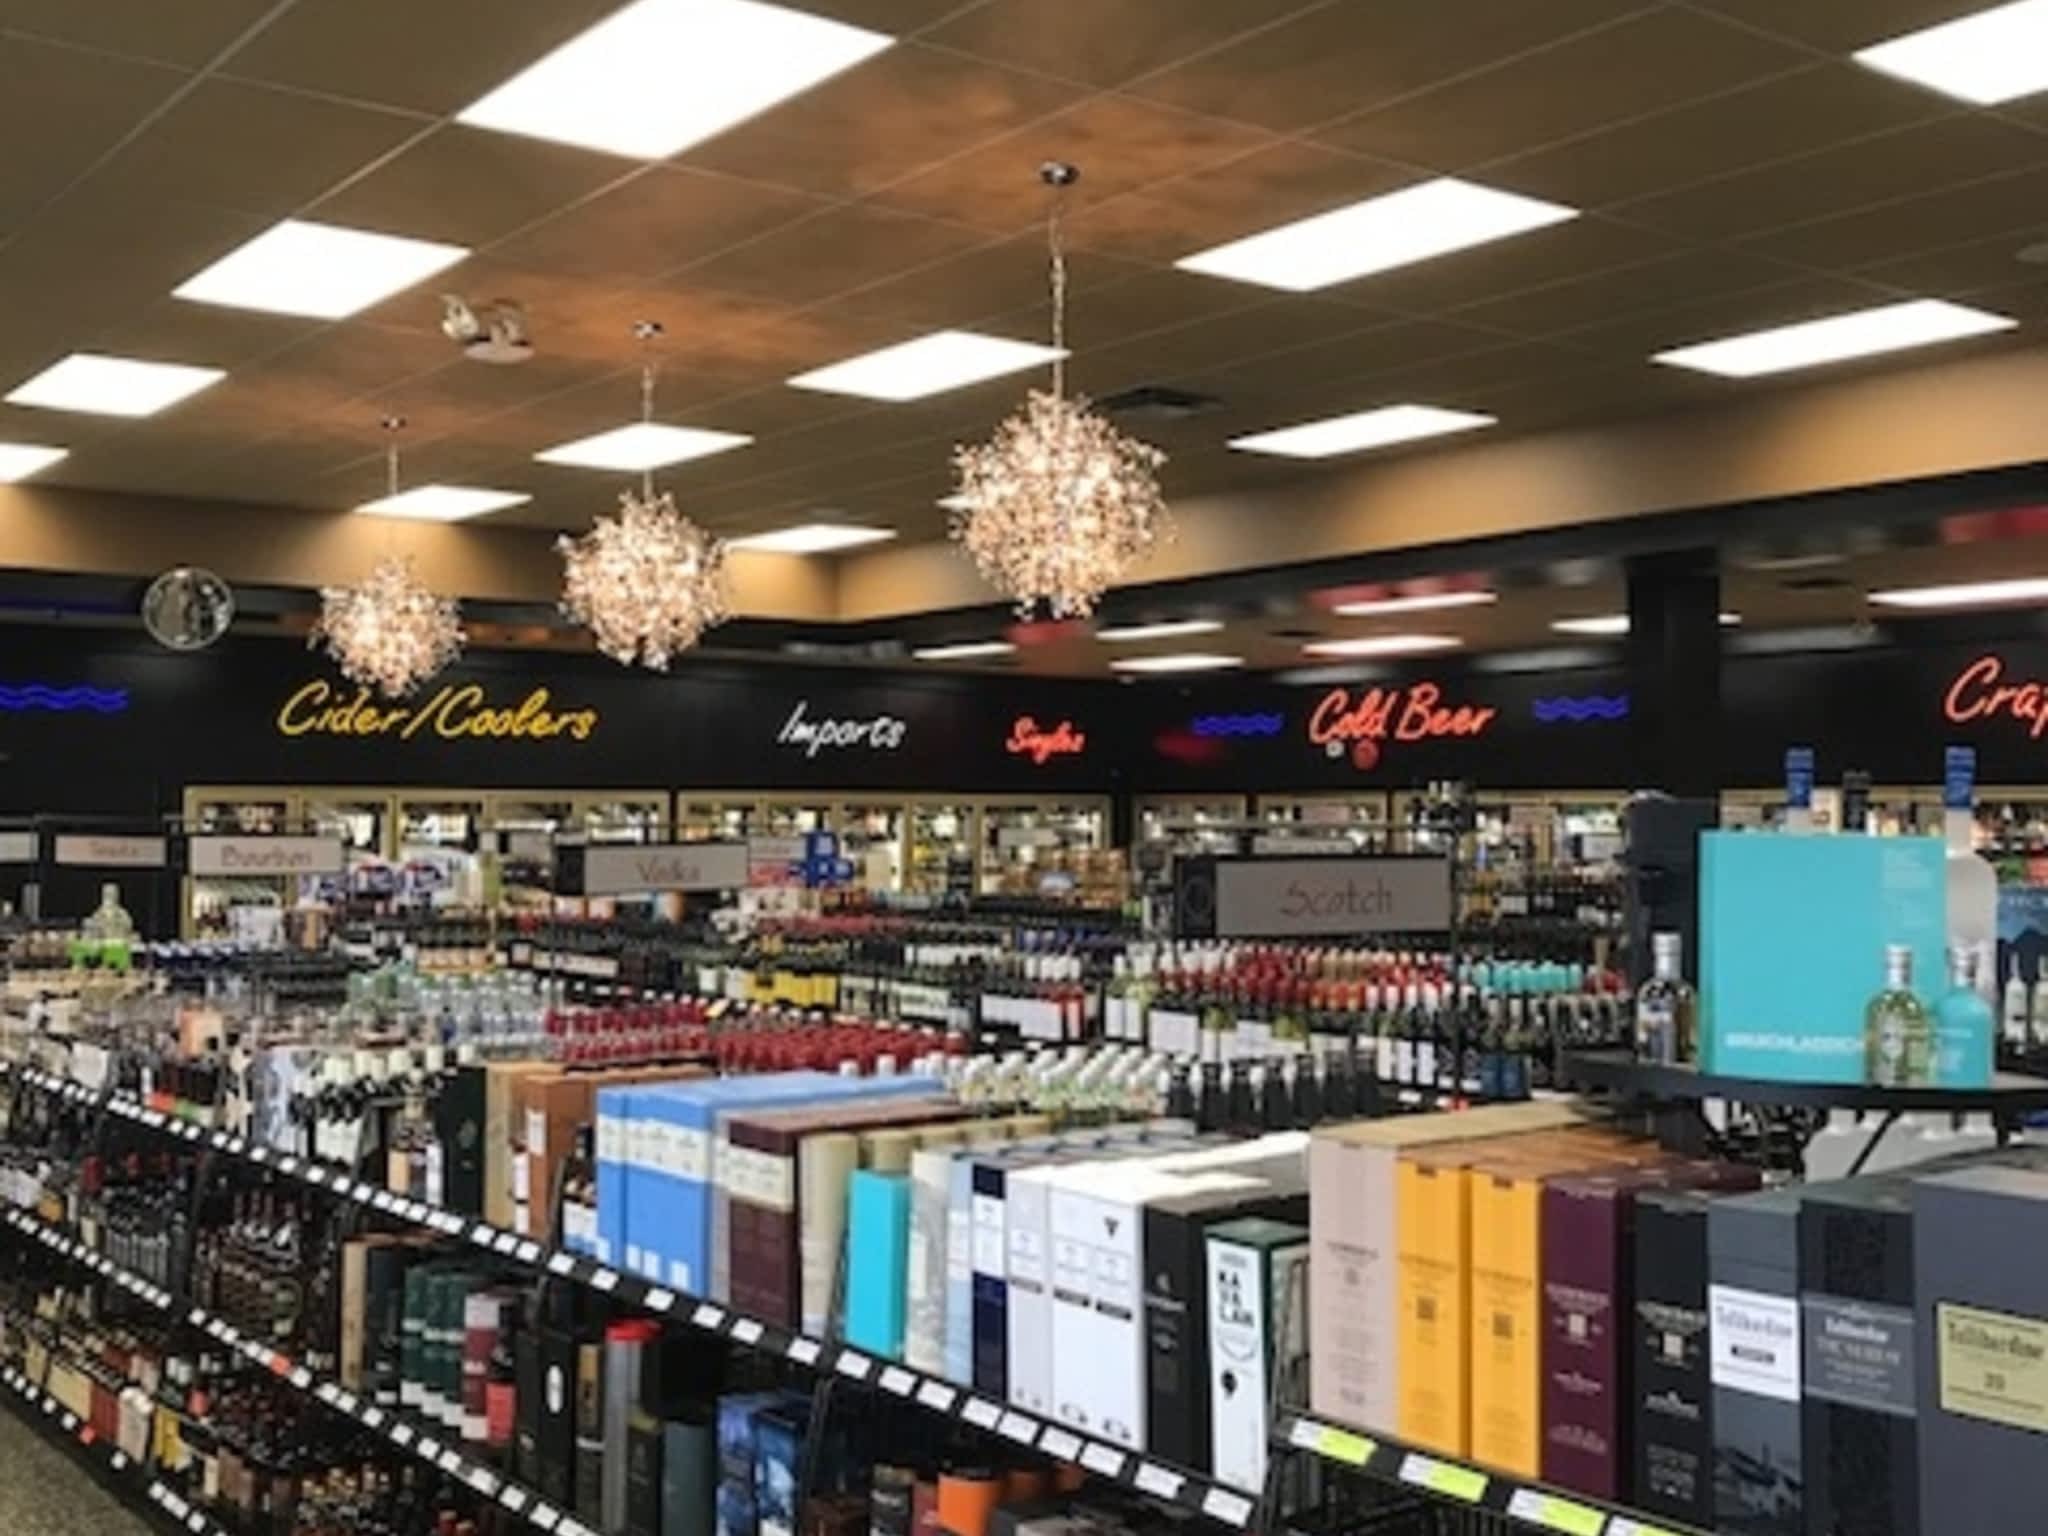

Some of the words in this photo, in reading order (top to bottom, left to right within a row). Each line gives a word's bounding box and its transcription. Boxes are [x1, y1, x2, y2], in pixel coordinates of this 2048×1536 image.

[277, 680, 597, 739] Cider/Coolers
[777, 700, 905, 758] Imports
[1309, 687, 1398, 743] Cold
[1395, 682, 1497, 740] Beer
[1280, 876, 1393, 918] Scotch
